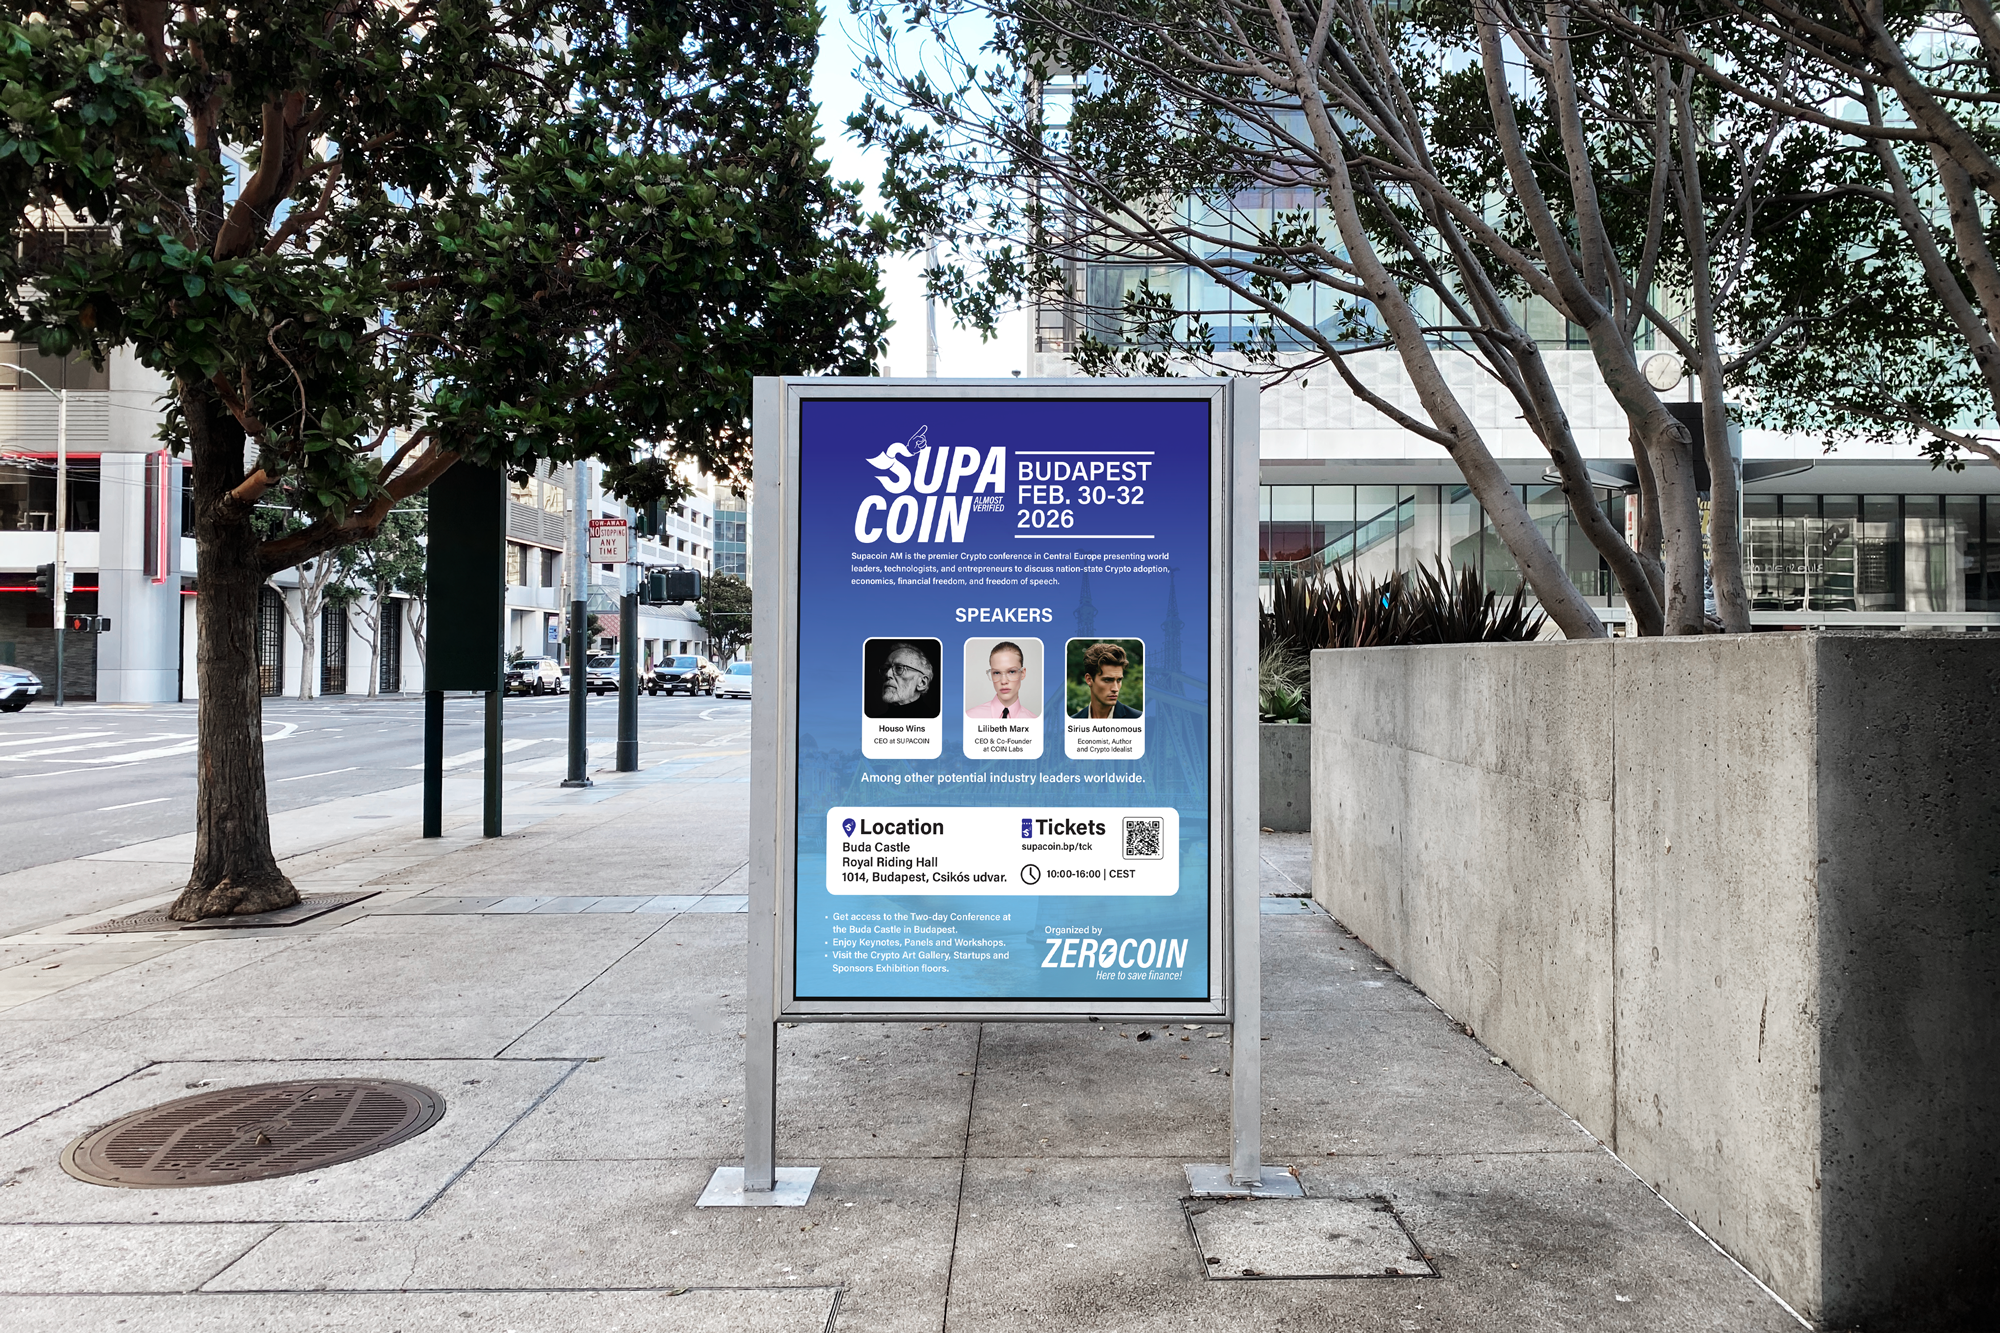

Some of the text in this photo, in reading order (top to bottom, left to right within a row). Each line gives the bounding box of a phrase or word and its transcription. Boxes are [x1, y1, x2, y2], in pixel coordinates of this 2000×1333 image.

[866, 441, 1006, 494] SUPA
[1019, 461, 1152, 481] BUDAPEST
[974, 496, 1003, 504] ALMOST
[1019, 485, 1144, 505] FEB. 30-32
[973, 504, 1005, 512] VERIFIED
[854, 495, 973, 544] COIN
[1017, 509, 1074, 528] 2026
[590, 527, 600, 537] NO
[851, 552, 887, 561] Supacoin
[905, 552, 912, 560] is
[913, 552, 926, 560] the
[928, 552, 958, 561] premier
[960, 552, 987, 561] Crypto
[988, 552, 1032, 560] conference
[1043, 552, 1072, 560] Central
[1074, 552, 1102, 561] Europe
[1103, 552, 1145, 562] presenting
[1147, 552, 1169, 560] world
[851, 564, 882, 573] leaders,
[884, 565, 939, 574] technologists,
[957, 565, 1013, 574] entrepreneurs
[1056, 565, 1103, 573] nation-state
[1105, 565, 1132, 574] Crypto
[1133, 565, 1170, 574] adoption,
[851, 577, 1060, 586] economics, financial freedom, and freedom of speech.
[955, 608, 1053, 622] SPEAKERS
[978, 725, 1007, 733] Lilibeth
[1067, 725, 1142, 733] Sirius Autonomous
[1089, 746, 1110, 754] Crypto
[861, 772, 1145, 785] Among other potential industry leaders worldwide.
[861, 818, 944, 835] Location
[1035, 818, 1106, 835] Tickets
[843, 842, 910, 852] Buda Castle
[1022, 842, 1093, 852] supacoin.bp/tck
[842, 856, 938, 870] Royal Riding Hall
[842, 871, 1007, 884] 1014, Budapest, Csikós udvar.
[1047, 869, 1101, 878] 10:00-16:00
[1109, 869, 1136, 878] CEST
[833, 912, 849, 921] Get
[883, 913, 892, 921] to
[894, 912, 908, 921] the
[910, 912, 948, 923] Two-day
[950, 912, 1001, 921] Conference
[1002, 913, 1011, 921] at
[832, 925, 958, 935] the Buda Castle in Budapest.
[1045, 925, 1102, 936] Organized by
[833, 938, 1006, 948] Enjoy Keynotes, Panels and Workshops.
[832, 950, 1009, 961] Visit the Crypto Art Gallery, Startups and
[1041, 938, 1189, 968] ZEROCOIN
[832, 964, 949, 974] Sponsors Exhibition floors.
[1096, 970, 1183, 980] Here to save finance!
